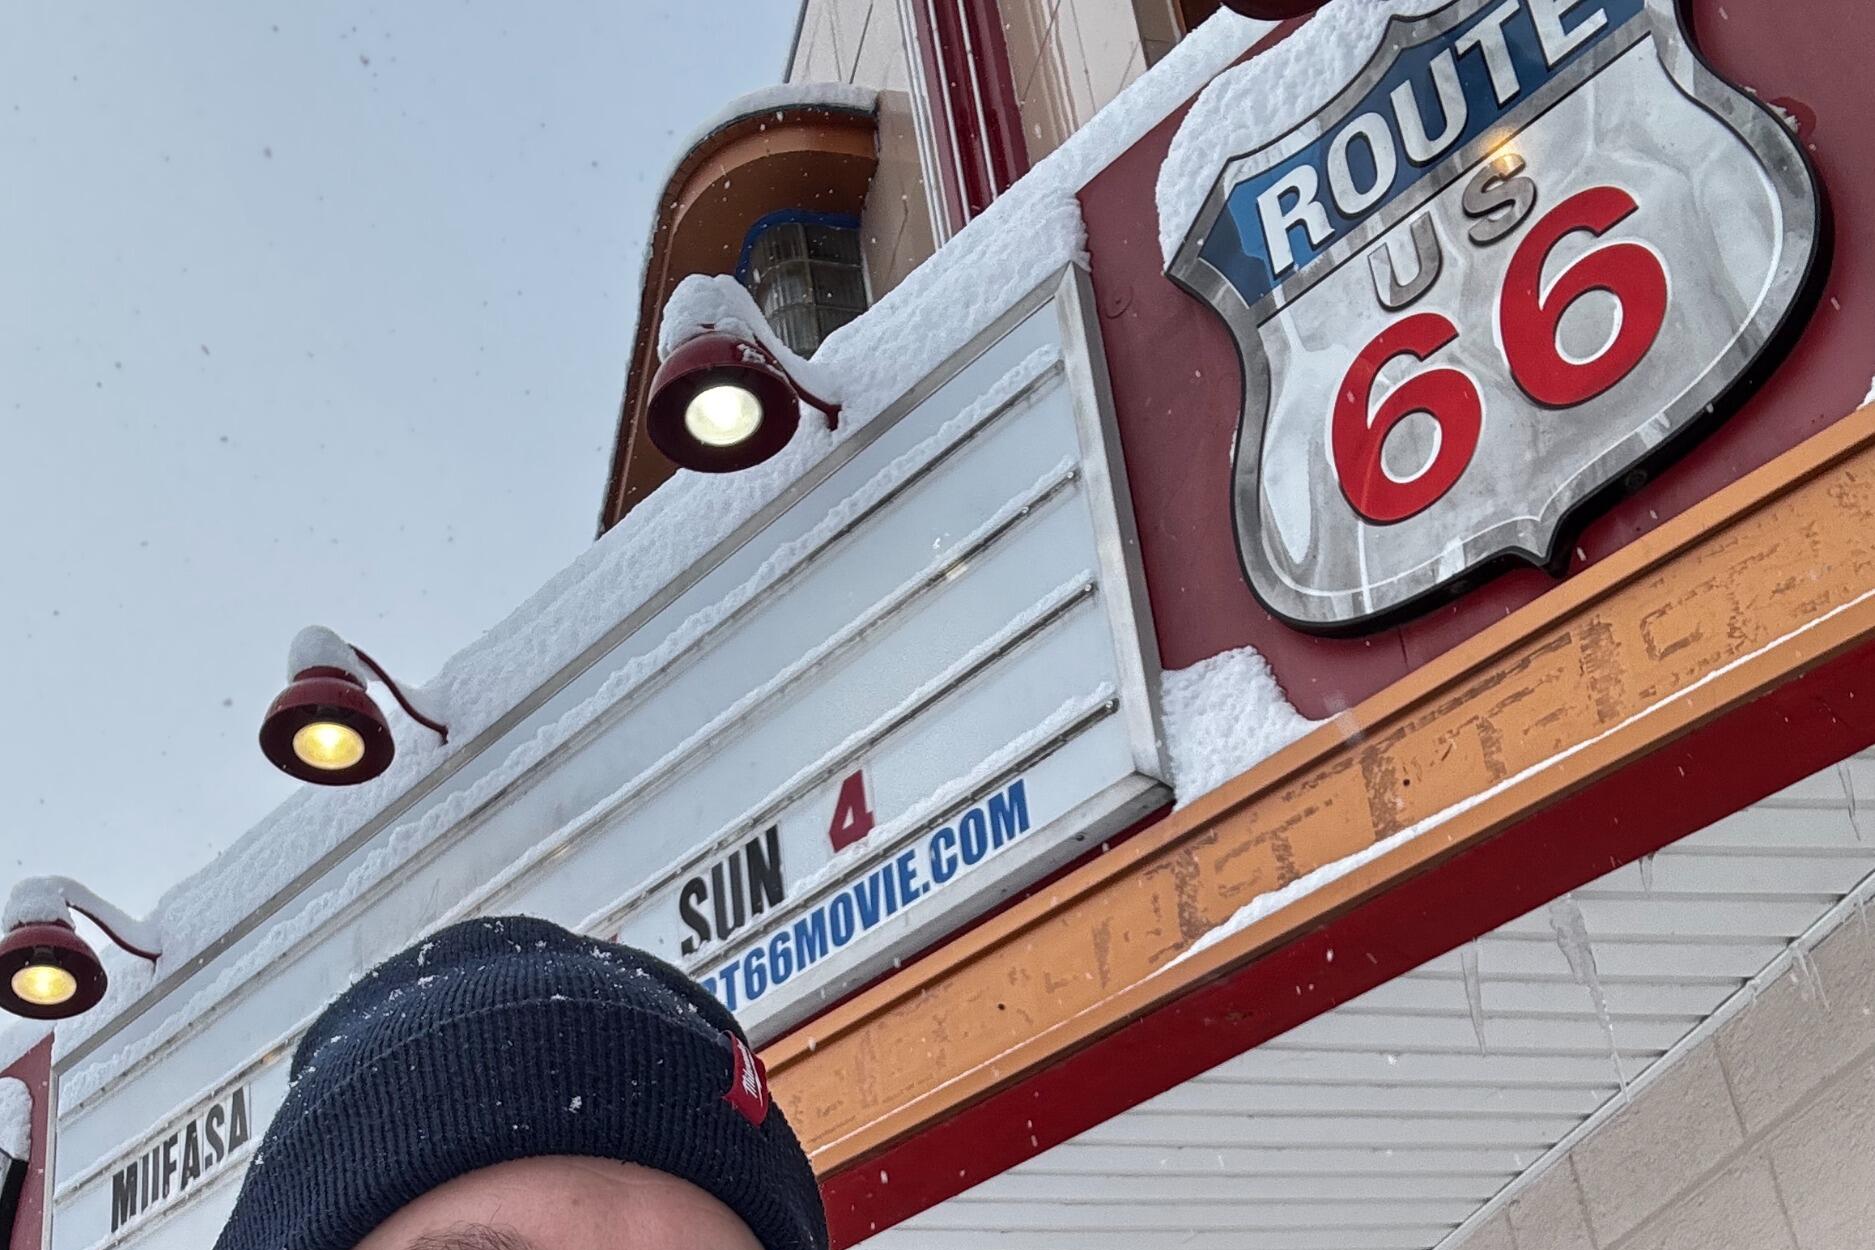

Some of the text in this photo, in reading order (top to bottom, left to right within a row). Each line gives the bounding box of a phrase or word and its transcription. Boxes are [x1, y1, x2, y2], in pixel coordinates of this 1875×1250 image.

[1256, 0, 1607, 277] ROUTE
[1367, 152, 1537, 313] US
[1332, 186, 1668, 526] 66
[680, 769, 876, 957] SUN 4
